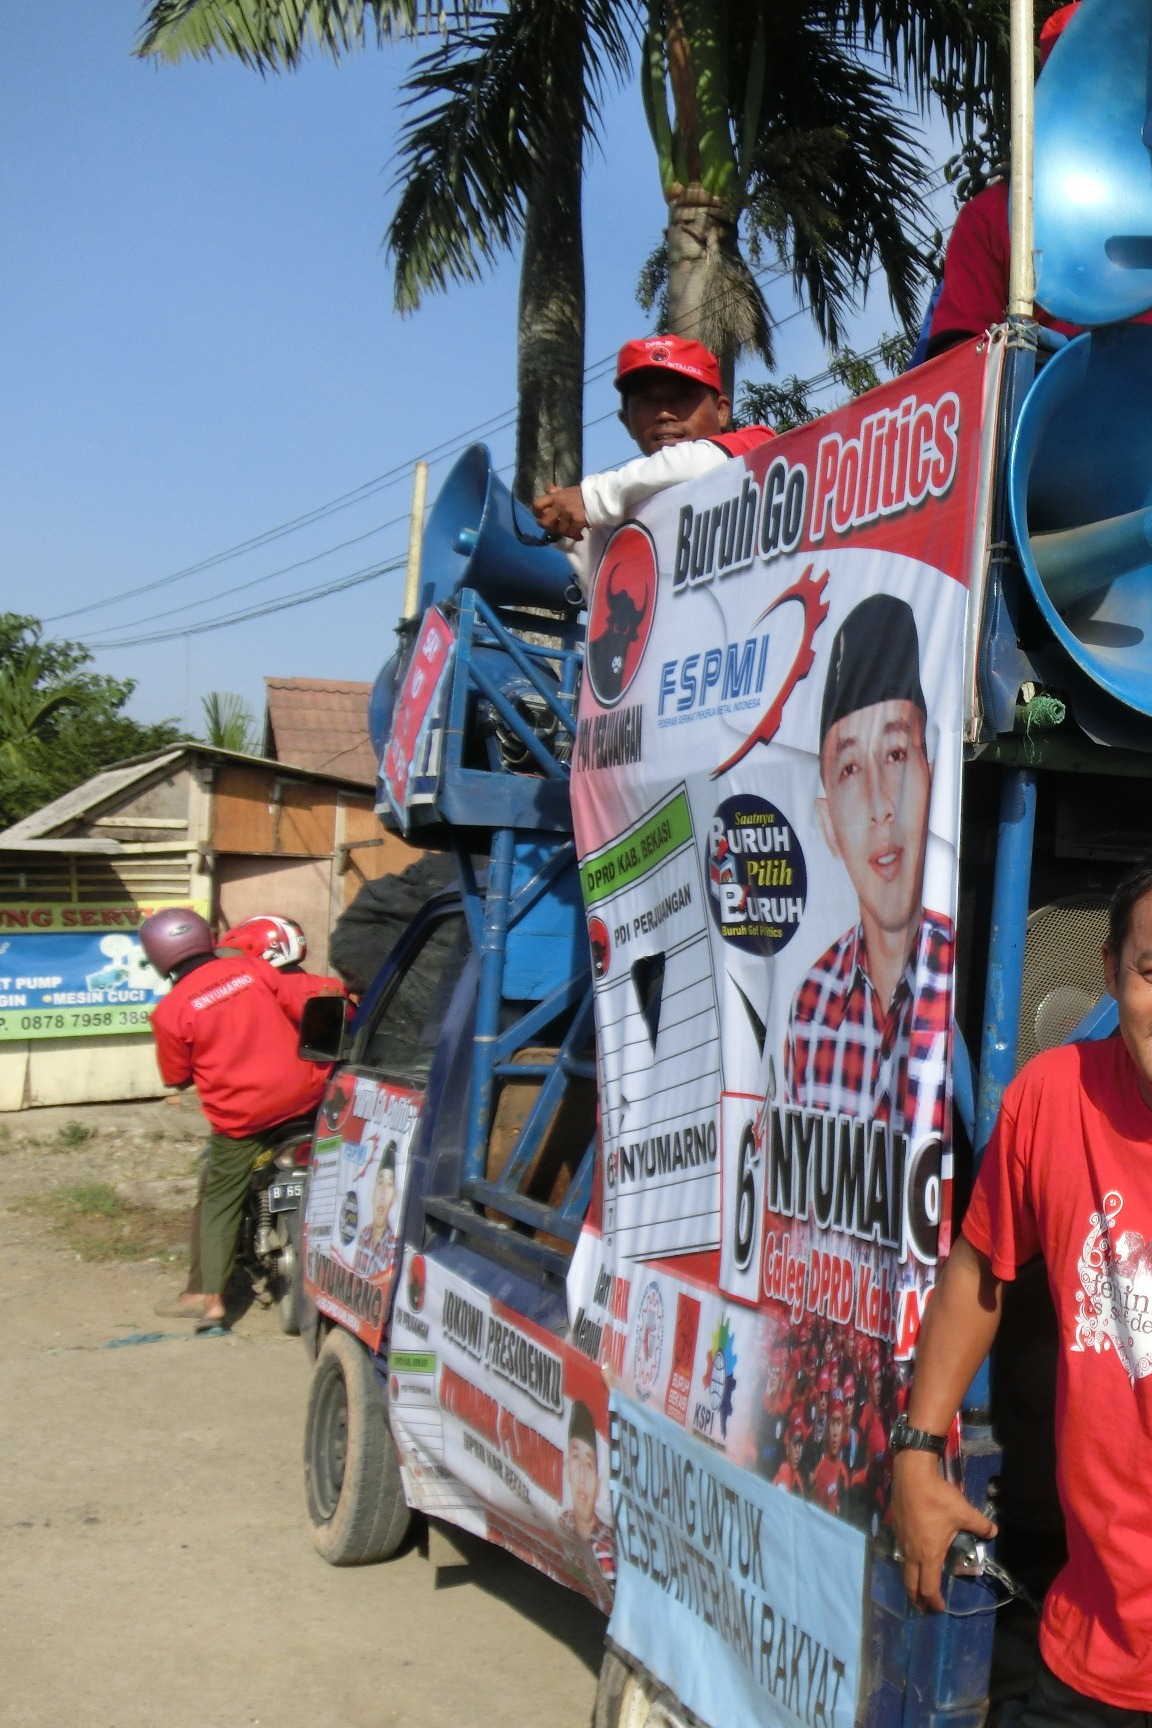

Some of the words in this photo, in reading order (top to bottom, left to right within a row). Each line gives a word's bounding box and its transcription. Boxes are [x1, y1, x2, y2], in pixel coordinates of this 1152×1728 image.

[672, 469, 760, 597] Buruh
[758, 455, 808, 560] Go
[809, 391, 960, 543] Politics
[658, 634, 770, 715] FSPMI
[710, 816, 790, 854] BURUH
[734, 811, 775, 830] Saatnya
[587, 858, 616, 894] DPRD
[617, 846, 642, 876] KAB.
[640, 818, 672, 862] BEKASI
[746, 859, 793, 887] Pilih
[612, 921, 632, 949] PDI
[632, 882, 693, 940] PERJUANGAN
[721, 882, 802, 924] BURUH
[722, 924, 747, 937] Buruh
[16, 976, 62, 990] PUMP
[53, 991, 102, 1004] MESIN
[108, 990, 146, 1003] CUCI
[200, 975, 253, 1005] NYUMARNO
[21, 1015, 64, 1030] 0878
[71, 1012, 112, 1027] 7958
[605, 1153, 616, 1190] 6
[619, 1119, 716, 1185] NYUMARNO
[734, 1117, 759, 1271] 6
[762, 1231, 808, 1326] Caleg
[807, 1249, 854, 1326] DPRD
[855, 1261, 898, 1345] Kab.
[441, 1289, 485, 1357] JOKOWI
[485, 1317, 564, 1412] PRESIDENKU
[693, 1402, 714, 1435] KSPI
[609, 1411, 698, 1539] BERJUANG
[698, 1467, 767, 1592] UNTUK
[610, 1490, 757, 1679] KESEJAHTERAAN
[759, 1605, 846, 1728] RAKYAT
